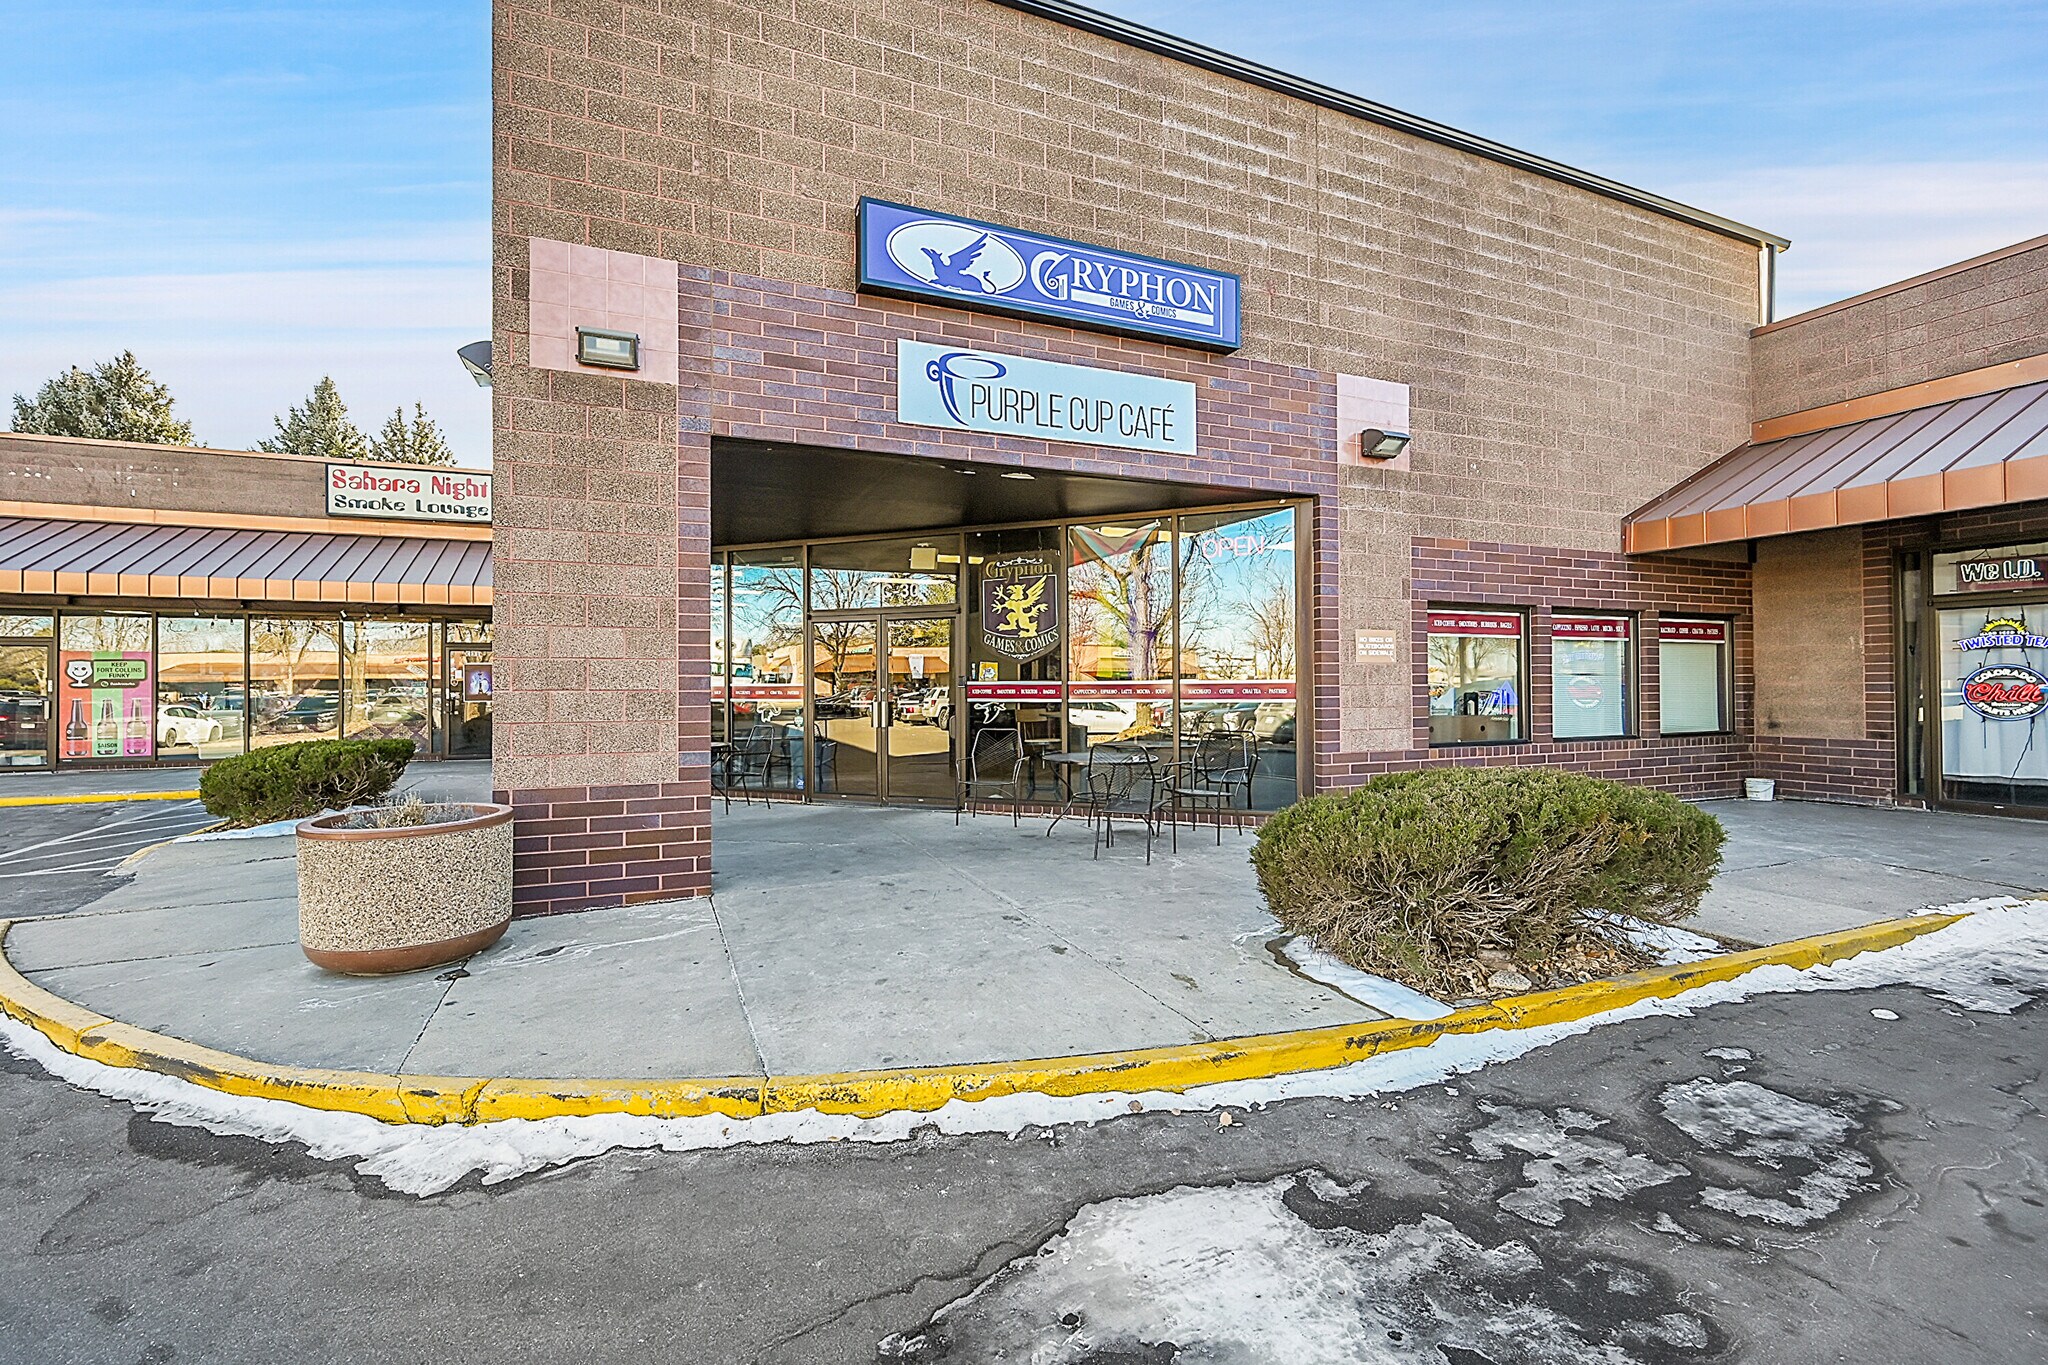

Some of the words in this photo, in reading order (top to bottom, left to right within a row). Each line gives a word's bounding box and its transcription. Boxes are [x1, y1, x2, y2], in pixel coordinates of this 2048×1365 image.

[1030, 251, 1216, 314] GRYPHON
[1109, 298, 1135, 311] GAMES
[1134, 300, 1151, 319] &
[1151, 304, 1177, 318] COMICS
[971, 383, 1063, 429] PURPLE
[1069, 396, 1114, 433] CUP
[1119, 403, 1175, 442] CAFÉ
[332, 468, 420, 493] Sahara
[432, 475, 488, 501] Night
[334, 494, 406, 512] Smoke
[416, 499, 489, 518] Lounge
[1203, 535, 1265, 559] OPEN
[1960, 562, 2000, 583] We
[984, 633, 1015, 653] GAMES
[1014, 640, 1025, 653] &
[1024, 629, 1059, 652] COMICS
[1957, 635, 2024, 652] TWISTED
[1974, 668, 2037, 683] COLORADO
[1966, 683, 2044, 702] Chill
